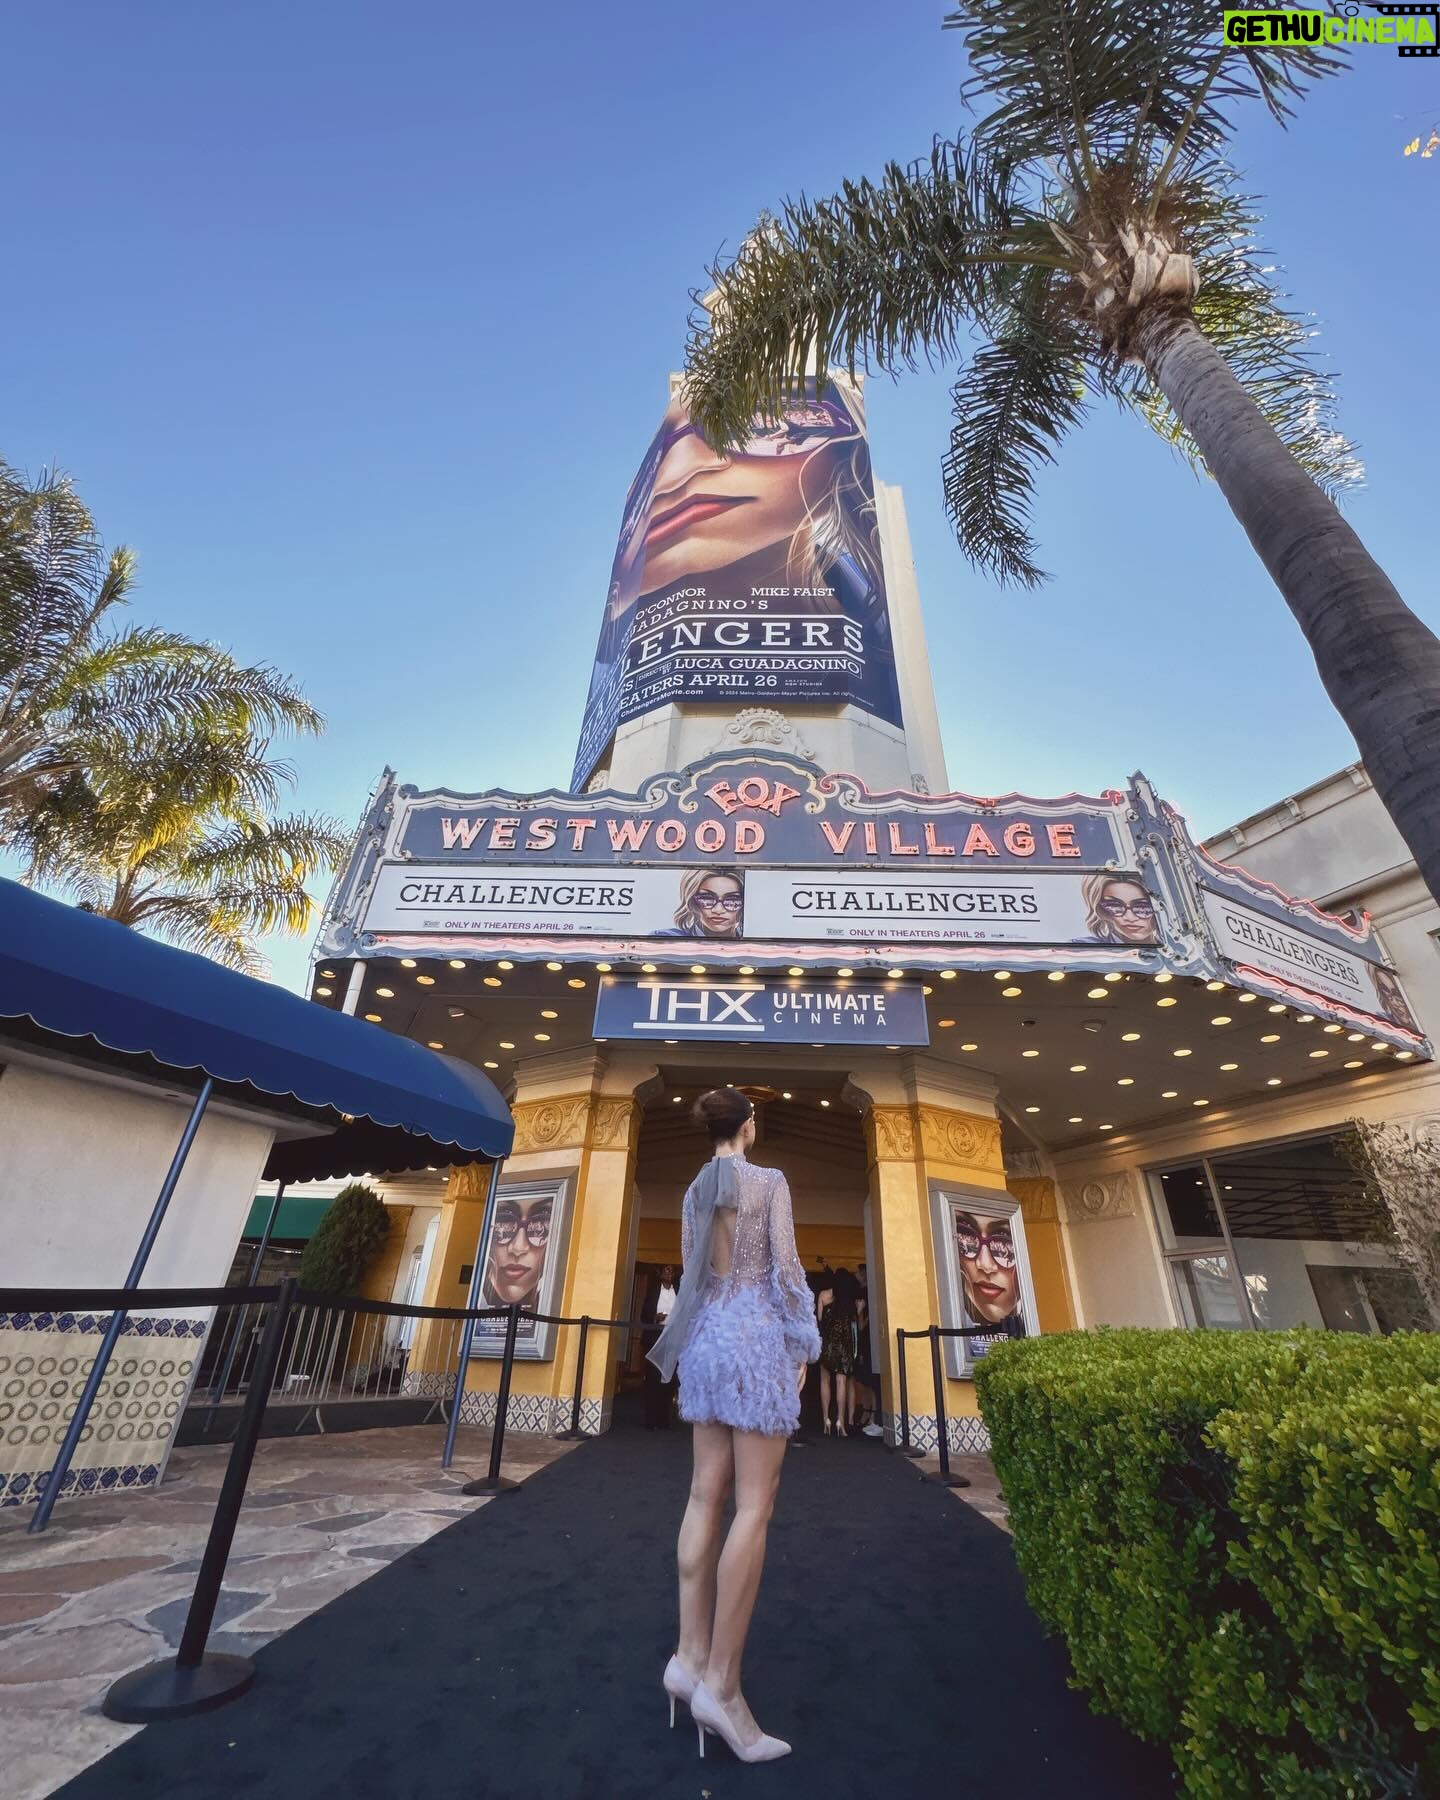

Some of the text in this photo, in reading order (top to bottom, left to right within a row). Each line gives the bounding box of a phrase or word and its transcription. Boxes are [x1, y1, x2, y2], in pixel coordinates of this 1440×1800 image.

[635, 587, 706, 620] O'CONNOR
[751, 587, 835, 596] MIKE FAIST
[674, 658, 860, 675] LUCA GUADAGNINO
[619, 674, 778, 711] EATERS APRIL 26
[620, 688, 704, 717] ChallengersMovie.com
[704, 776, 800, 817] FOX
[440, 817, 1082, 858] WESTWOOD VILLAGE
[399, 884, 634, 907] CHALLENGERS
[791, 890, 1038, 914] CHALLENGERS
[444, 921, 469, 929] ONLY
[471, 921, 481, 929] IN
[483, 921, 531, 930] THEATERS
[532, 922, 560, 931] APRIL
[562, 923, 574, 931] 26
[849, 928, 875, 937] ONLY
[877, 928, 888, 937] IN
[889, 929, 941, 938] THEATERS
[942, 930, 972, 938] APRIL
[974, 931, 986, 939] 26
[1225, 915, 1359, 985] CHALLENGERS
[637, 982, 765, 1023] THX
[773, 992, 886, 1012] ULTIMATE
[773, 1011, 887, 1026] CINEMA
